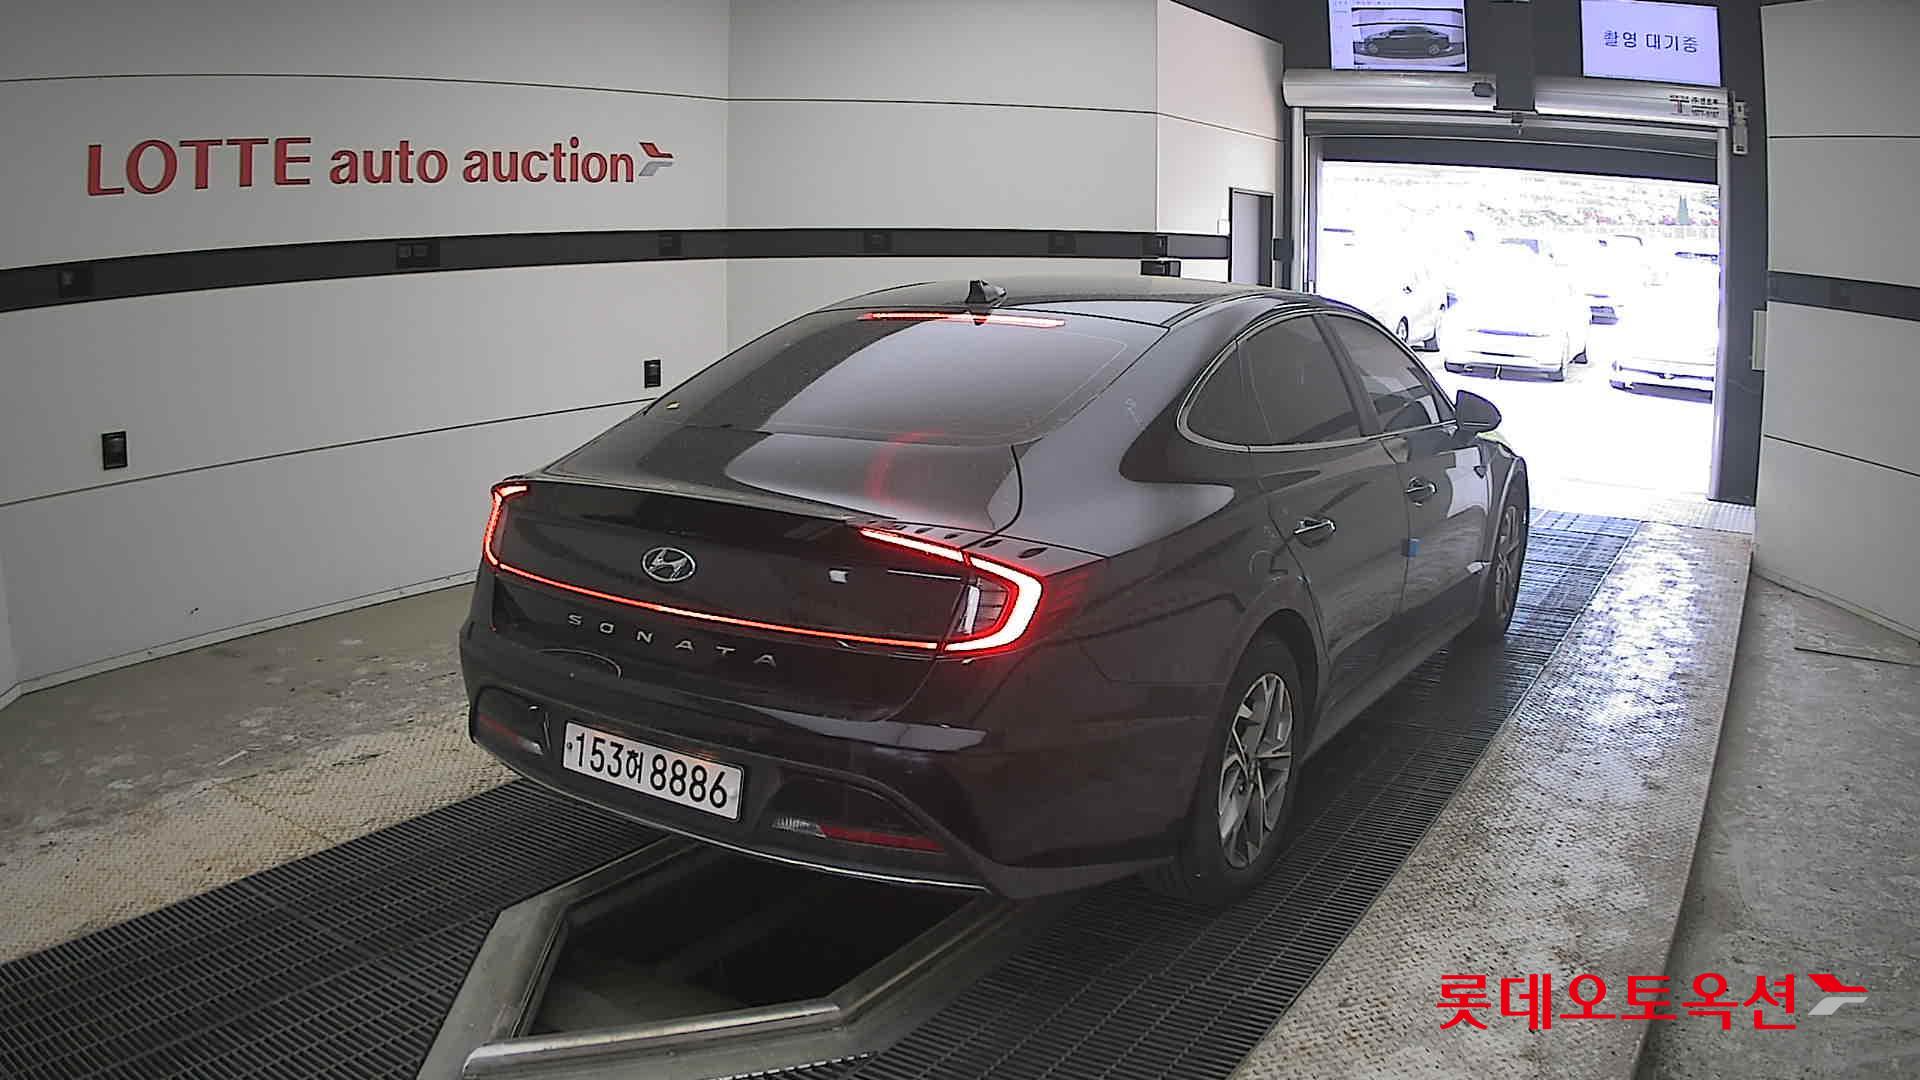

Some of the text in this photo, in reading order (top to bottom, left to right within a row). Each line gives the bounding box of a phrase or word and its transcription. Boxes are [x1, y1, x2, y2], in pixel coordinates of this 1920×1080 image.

[1646, 33, 1698, 53] 대기중
[87, 137, 634, 197] LOTTE auto auction
[567, 613, 777, 667] SONATA
[575, 732, 728, 809] 153허 8886
